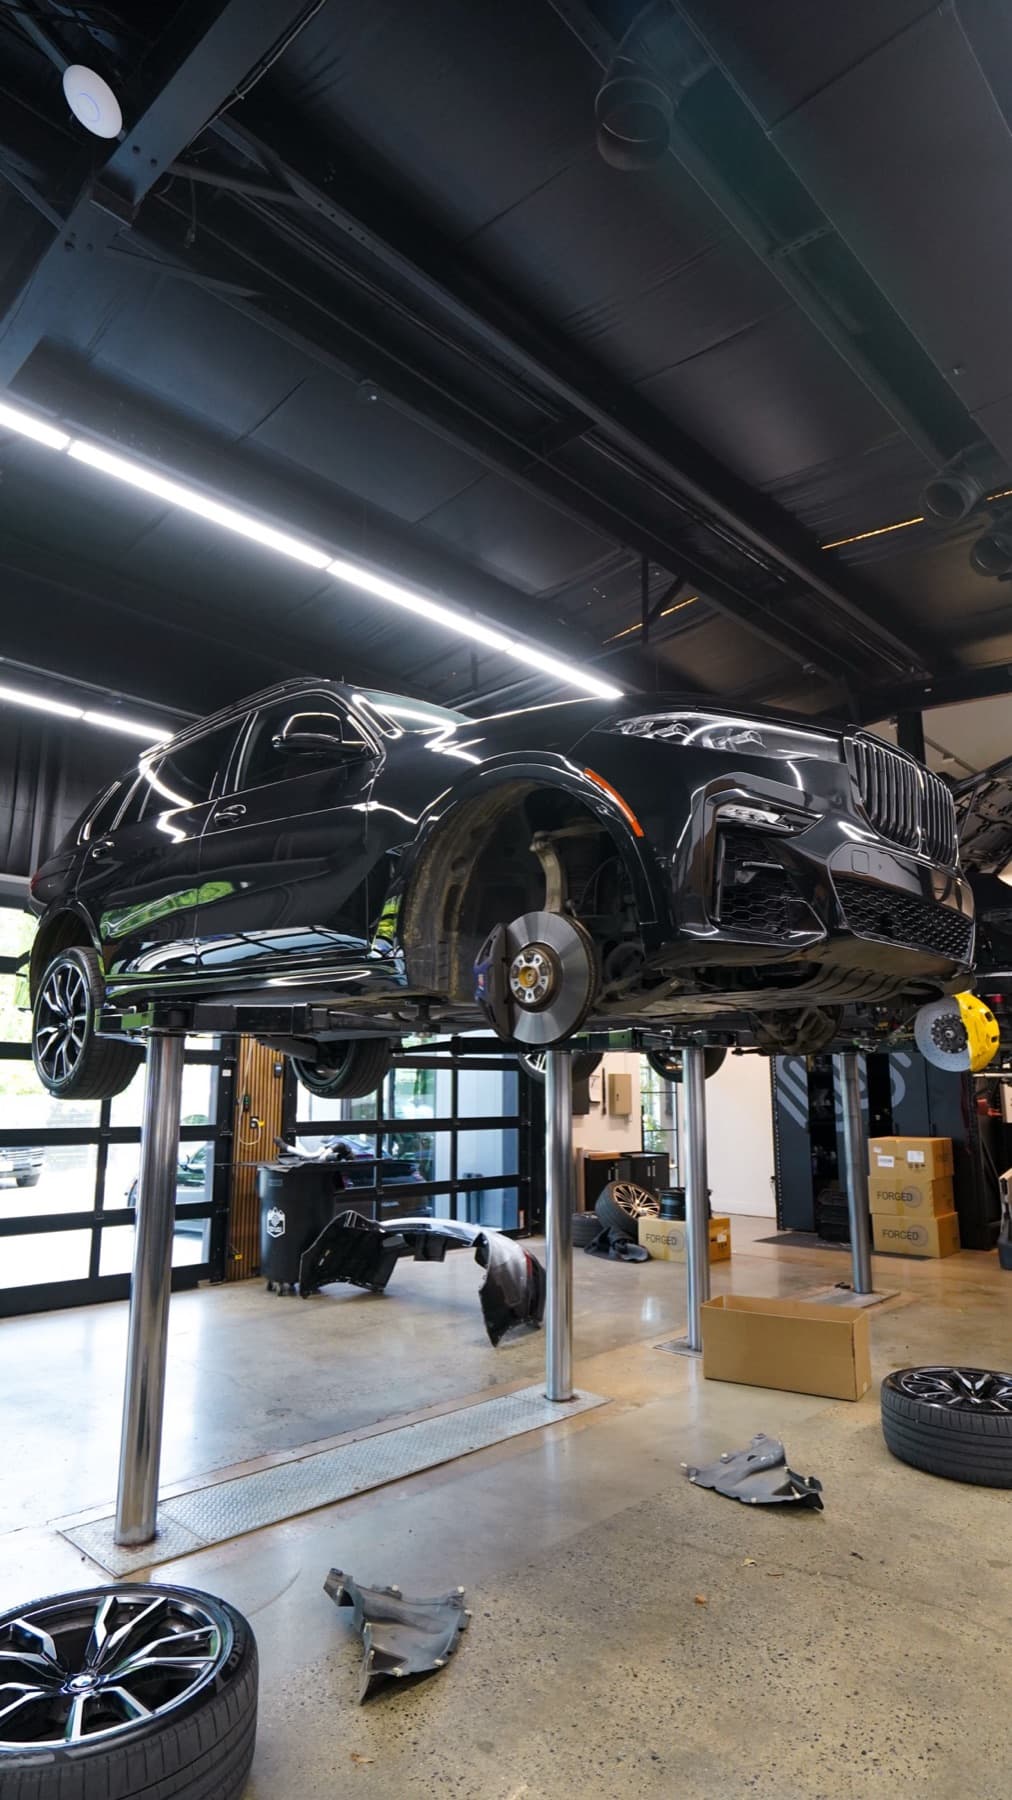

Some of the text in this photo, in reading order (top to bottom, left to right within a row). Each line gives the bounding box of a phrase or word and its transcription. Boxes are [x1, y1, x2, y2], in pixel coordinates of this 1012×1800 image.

[877, 1191, 913, 1202] FORGED
[645, 1233, 677, 1246] FORGED
[882, 1229, 919, 1241] FORGED
